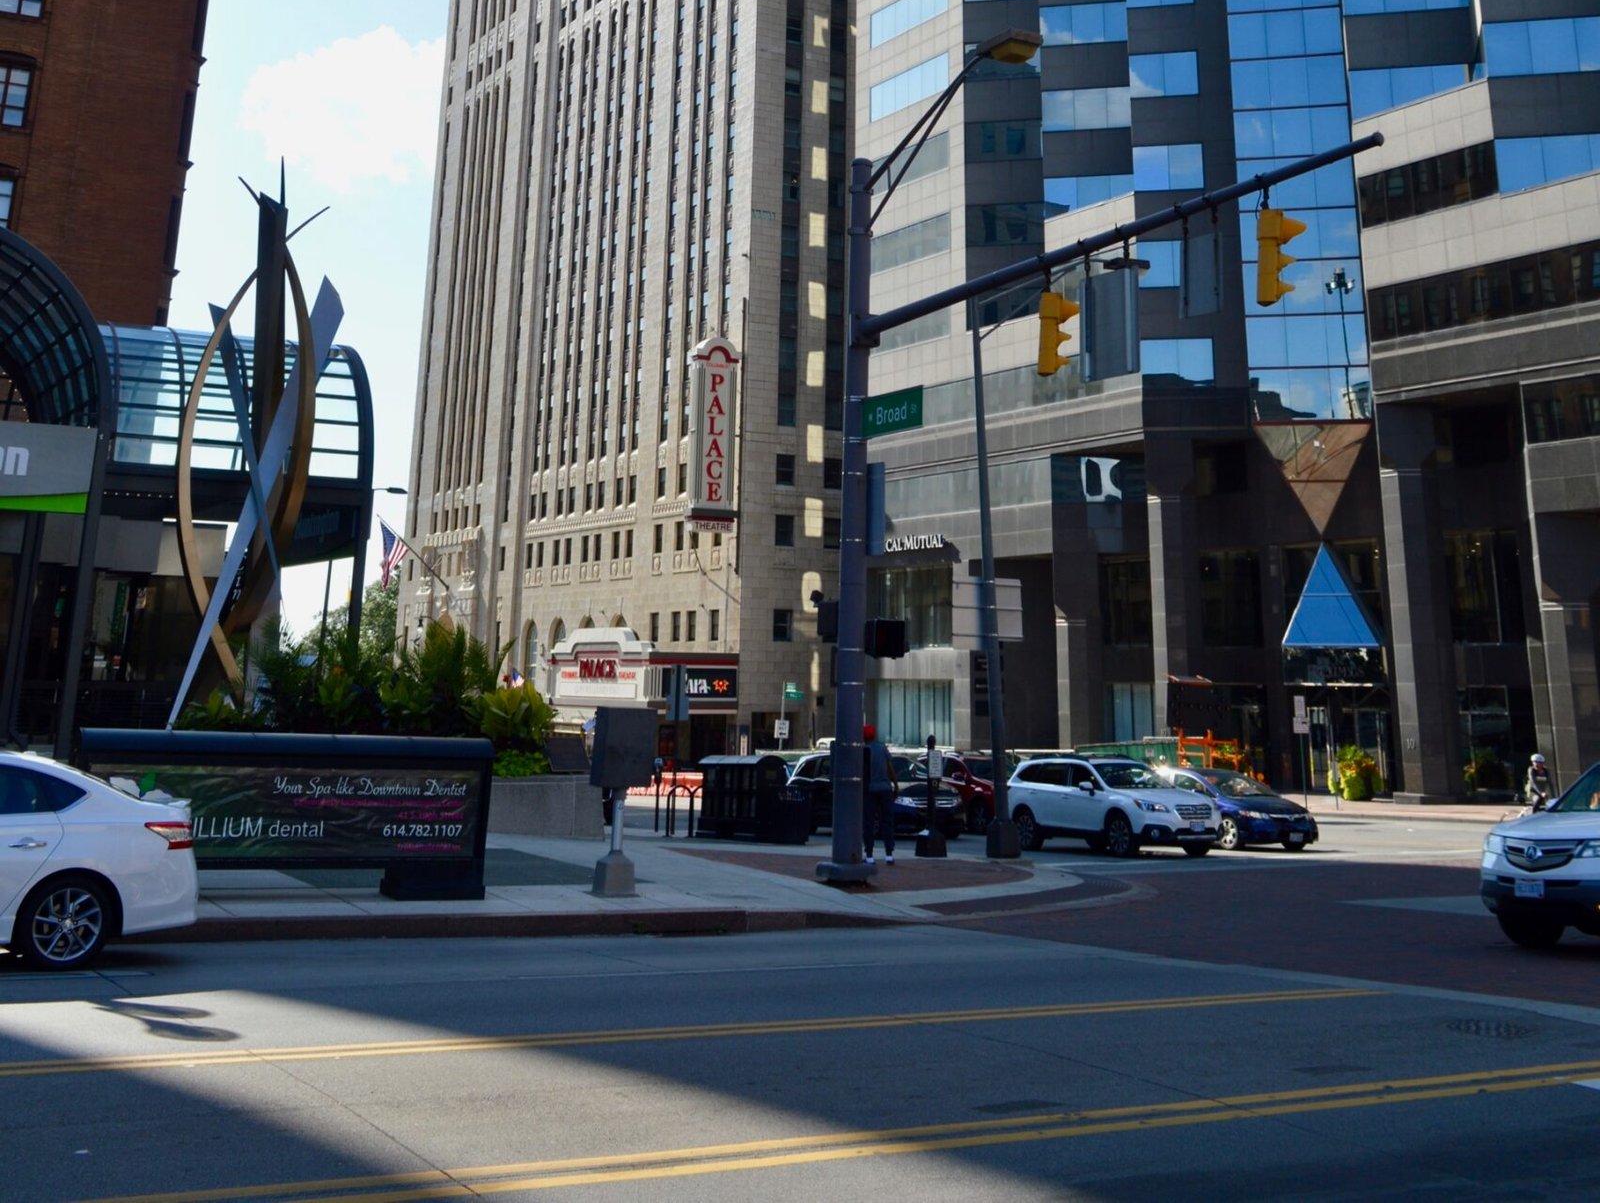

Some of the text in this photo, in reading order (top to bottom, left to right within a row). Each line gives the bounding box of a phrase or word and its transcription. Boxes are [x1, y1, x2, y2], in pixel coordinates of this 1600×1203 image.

[876, 400, 908, 425] Broad
[705, 373, 726, 502] PALACE
[694, 521, 733, 532] THEATRE
[884, 534, 944, 553] CAL MUTUAL
[273, 776, 467, 798] Your Spa-like Downtown Dentist
[193, 816, 324, 838] ILLIUM dental
[383, 824, 462, 838] 614.782.1107
